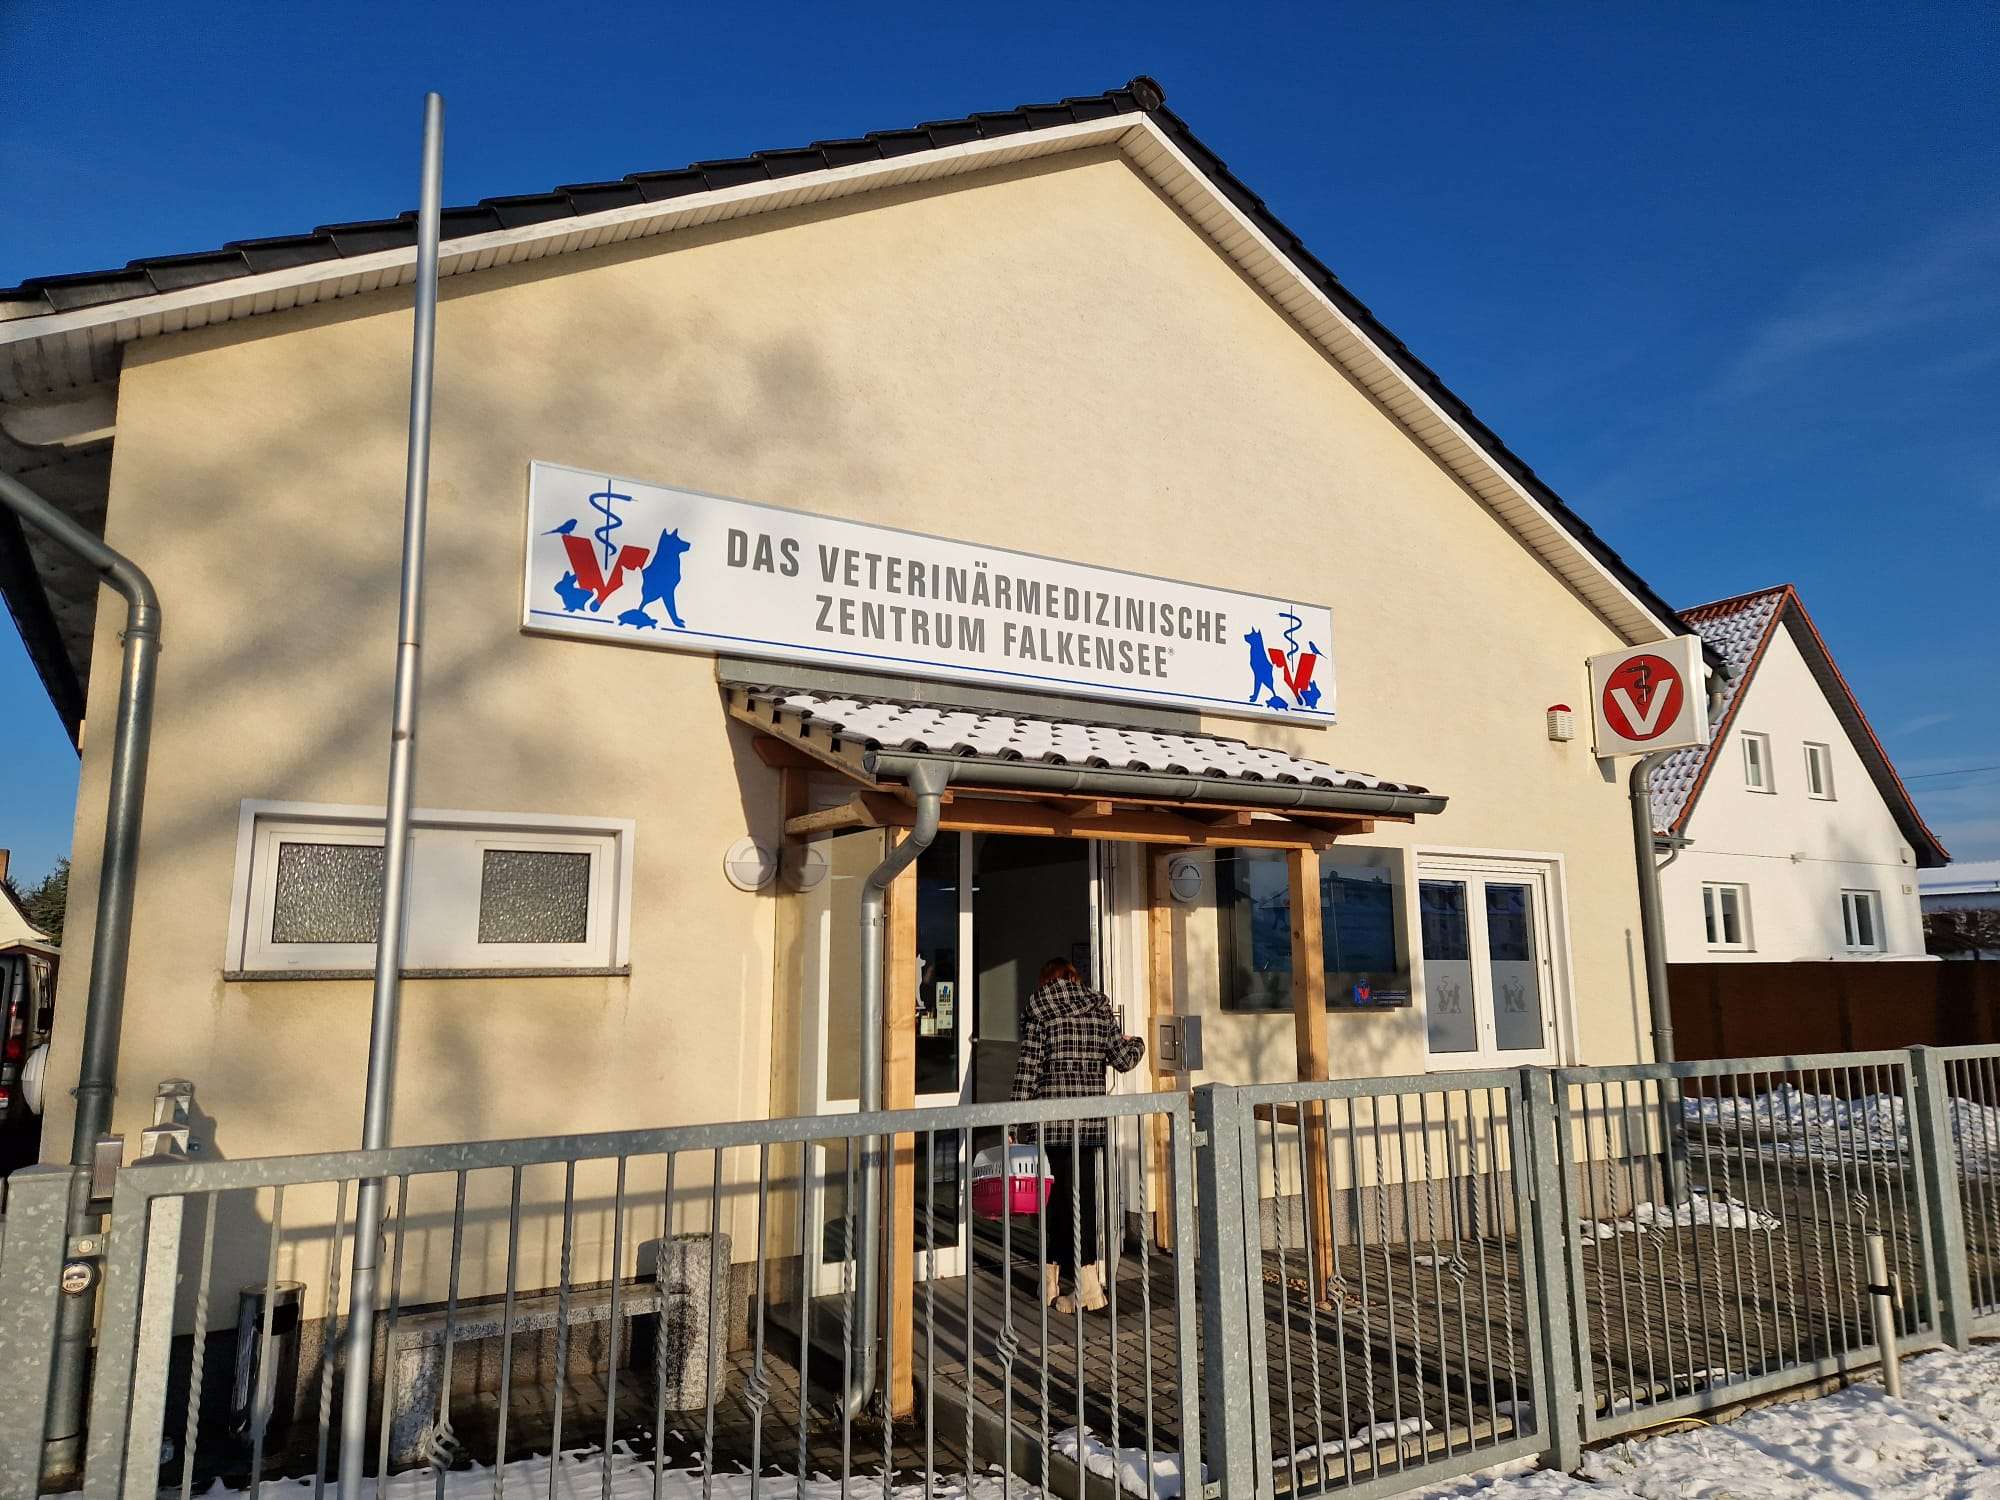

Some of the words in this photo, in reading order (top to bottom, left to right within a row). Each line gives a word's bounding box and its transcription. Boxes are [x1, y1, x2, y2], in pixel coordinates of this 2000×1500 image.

[726, 527, 800, 578] DAS
[818, 543, 1227, 645] VETERINÄRMEDIZINISCHE
[815, 594, 985, 654] ZENTRUM
[1610, 677, 1674, 737] V
